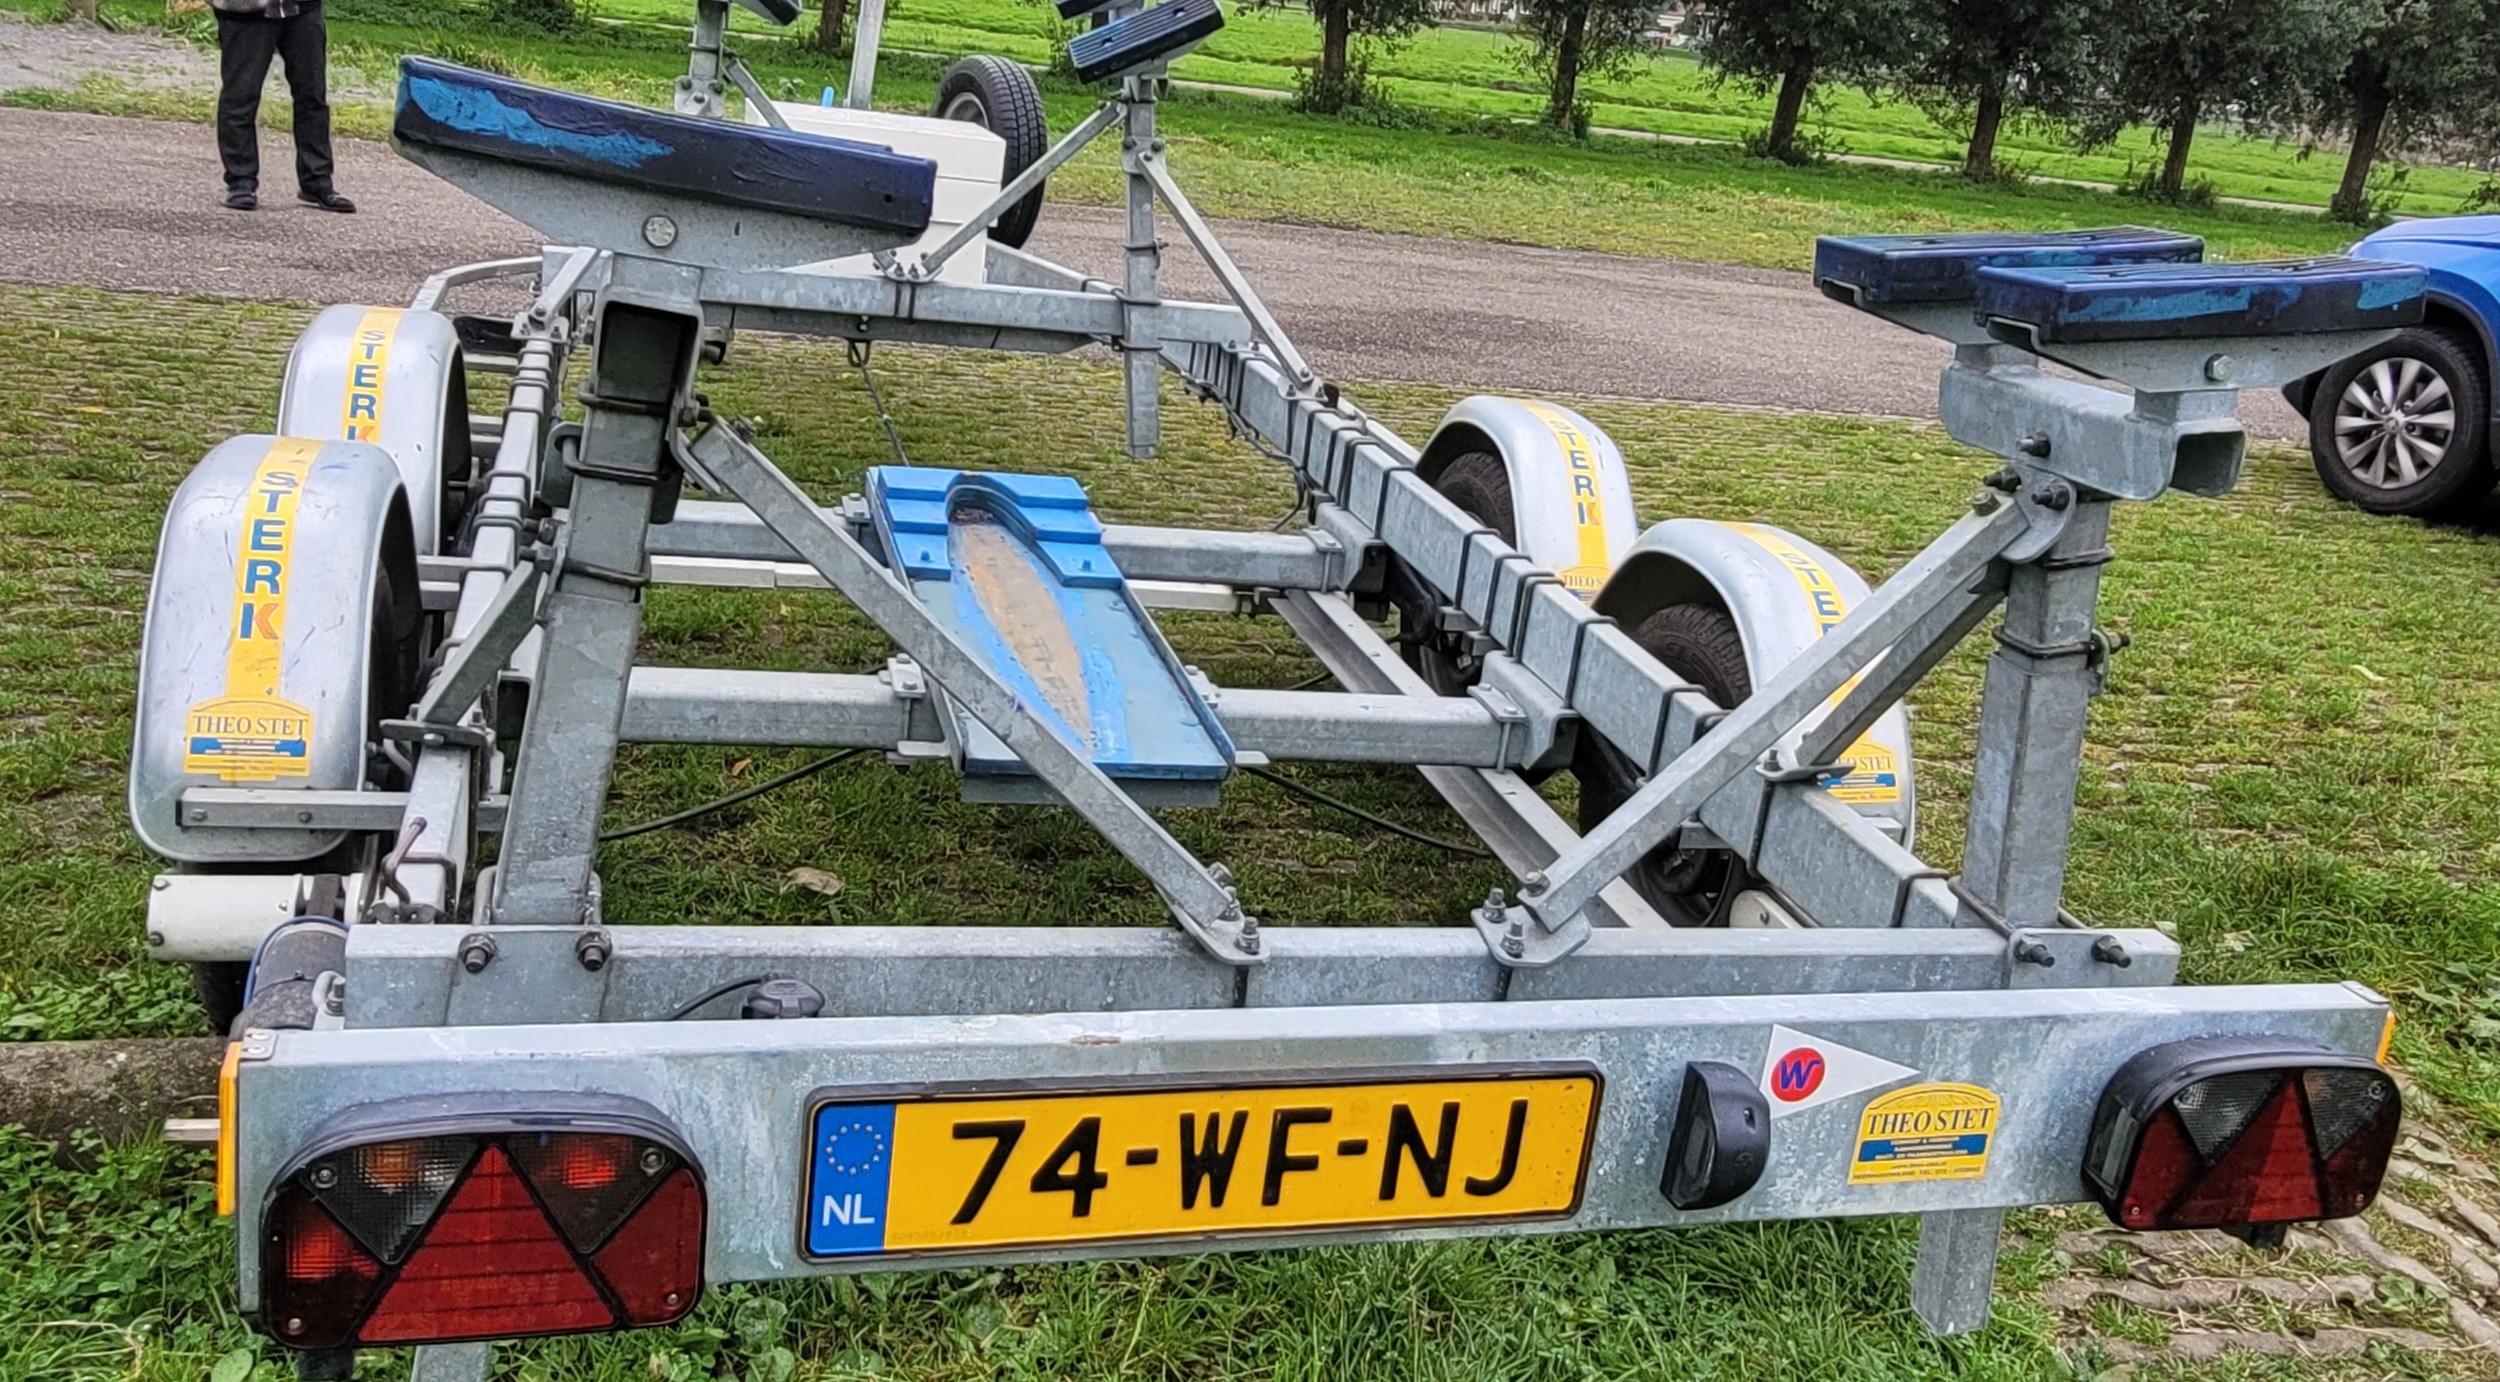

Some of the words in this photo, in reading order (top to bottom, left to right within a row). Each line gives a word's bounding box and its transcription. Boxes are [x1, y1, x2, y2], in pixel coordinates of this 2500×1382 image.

[1549, 420, 1601, 526] STERK
[239, 471, 299, 640] STERK
[193, 715, 252, 735] THEO
[256, 717, 309, 737] STET
[1860, 756, 1894, 771] STET
[1781, 1060, 1823, 1090] W
[1868, 1110, 1932, 1136] THEO
[1934, 1107, 1995, 1132] STET
[950, 1098, 1529, 1225] 74-WF-NJ
[822, 1193, 876, 1227] NL
